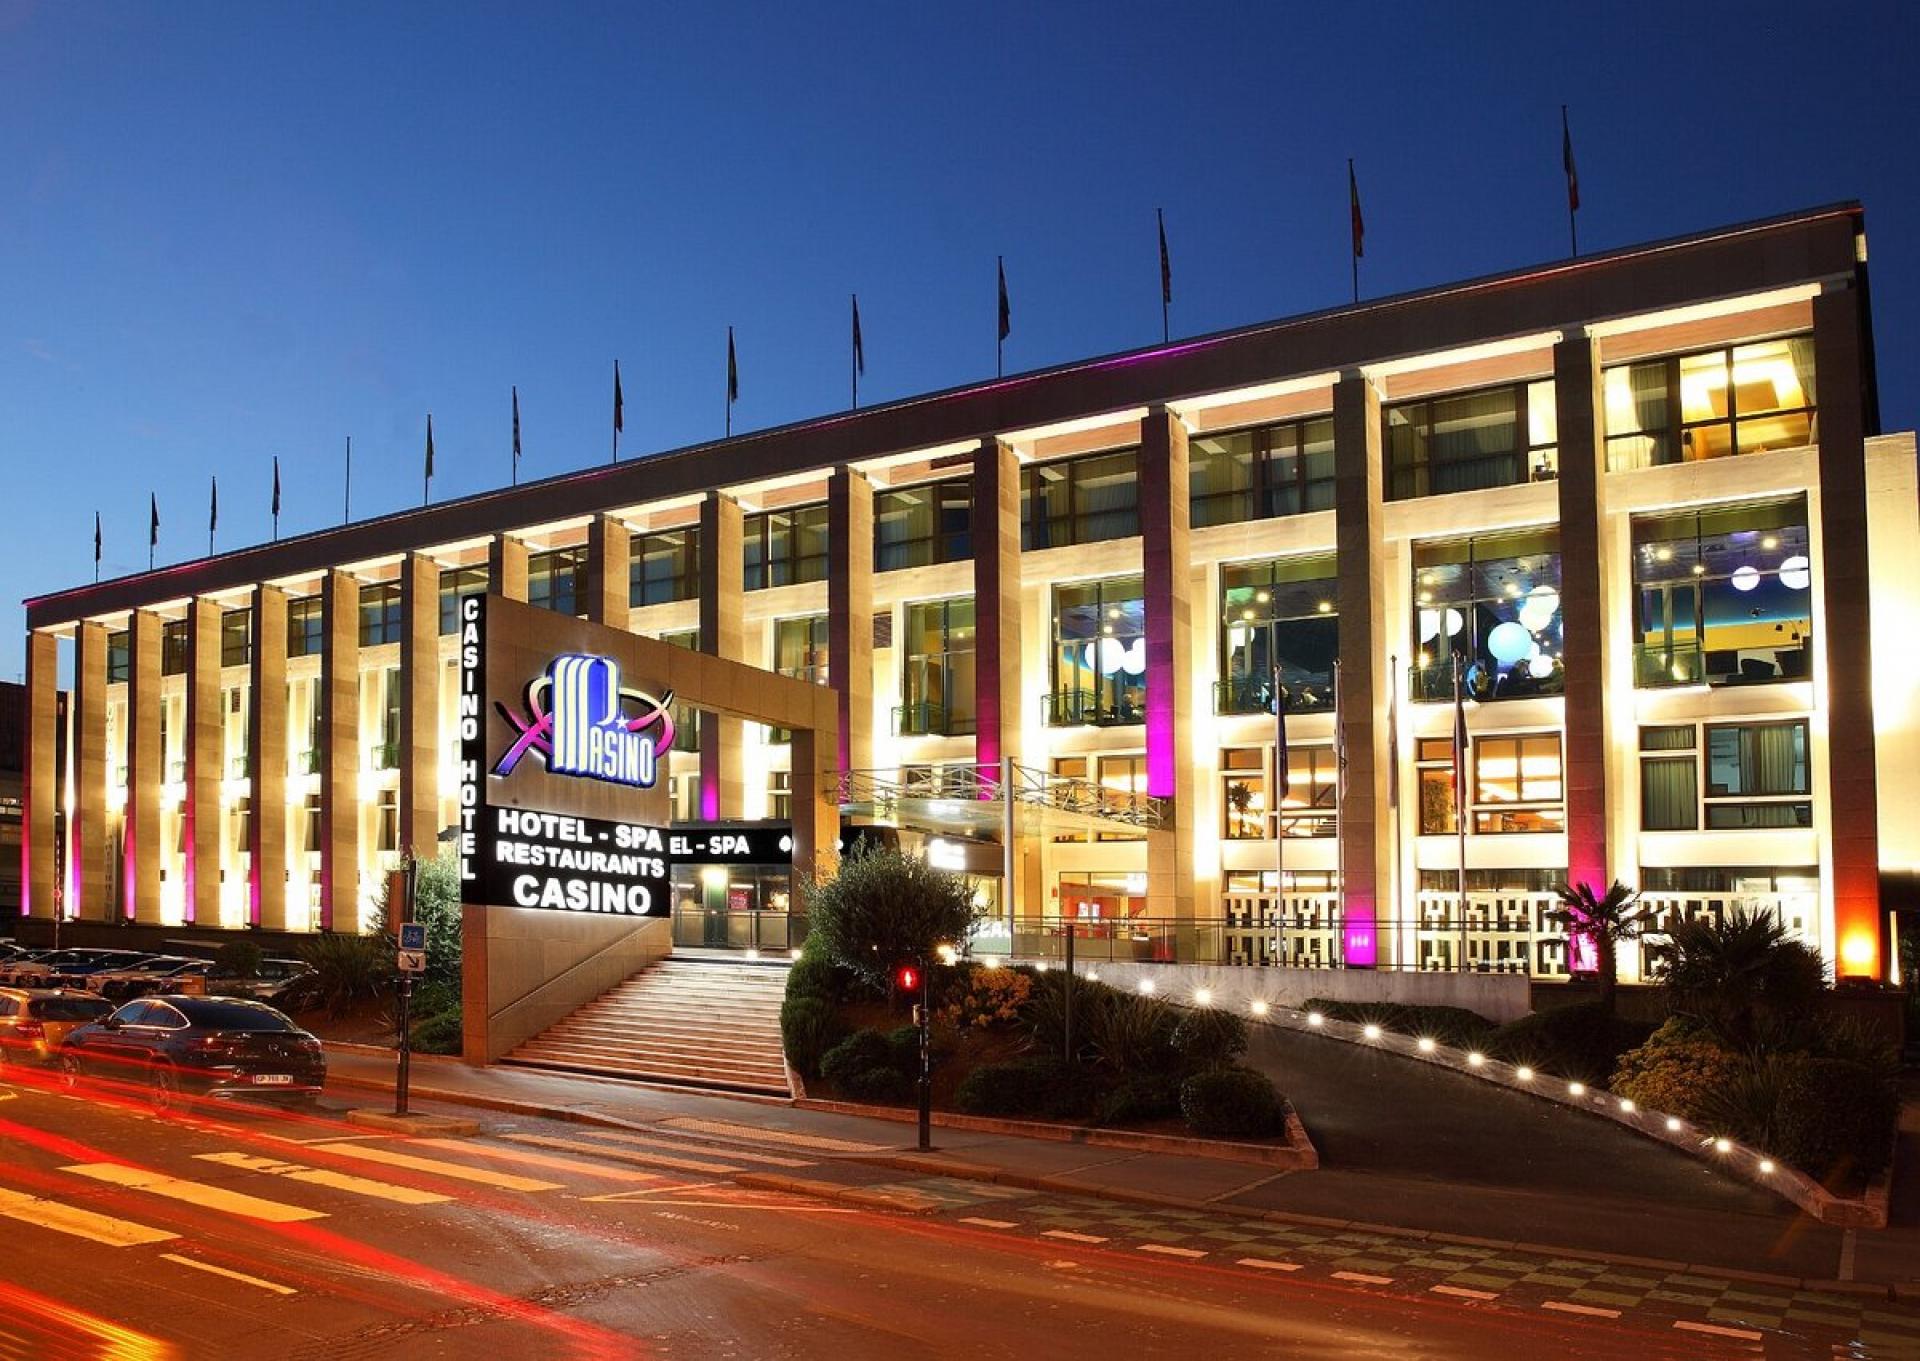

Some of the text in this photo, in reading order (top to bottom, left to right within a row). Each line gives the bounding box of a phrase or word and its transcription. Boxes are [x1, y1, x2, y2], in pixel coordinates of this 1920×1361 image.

[461, 599, 479, 880] CASINO HOTEL
[498, 808, 593, 844] HOTEL
[615, 824, 663, 852] SPA
[708, 835, 751, 855] SPA
[496, 840, 665, 879] RESTAURANTS
[513, 874, 651, 915] CASINO
